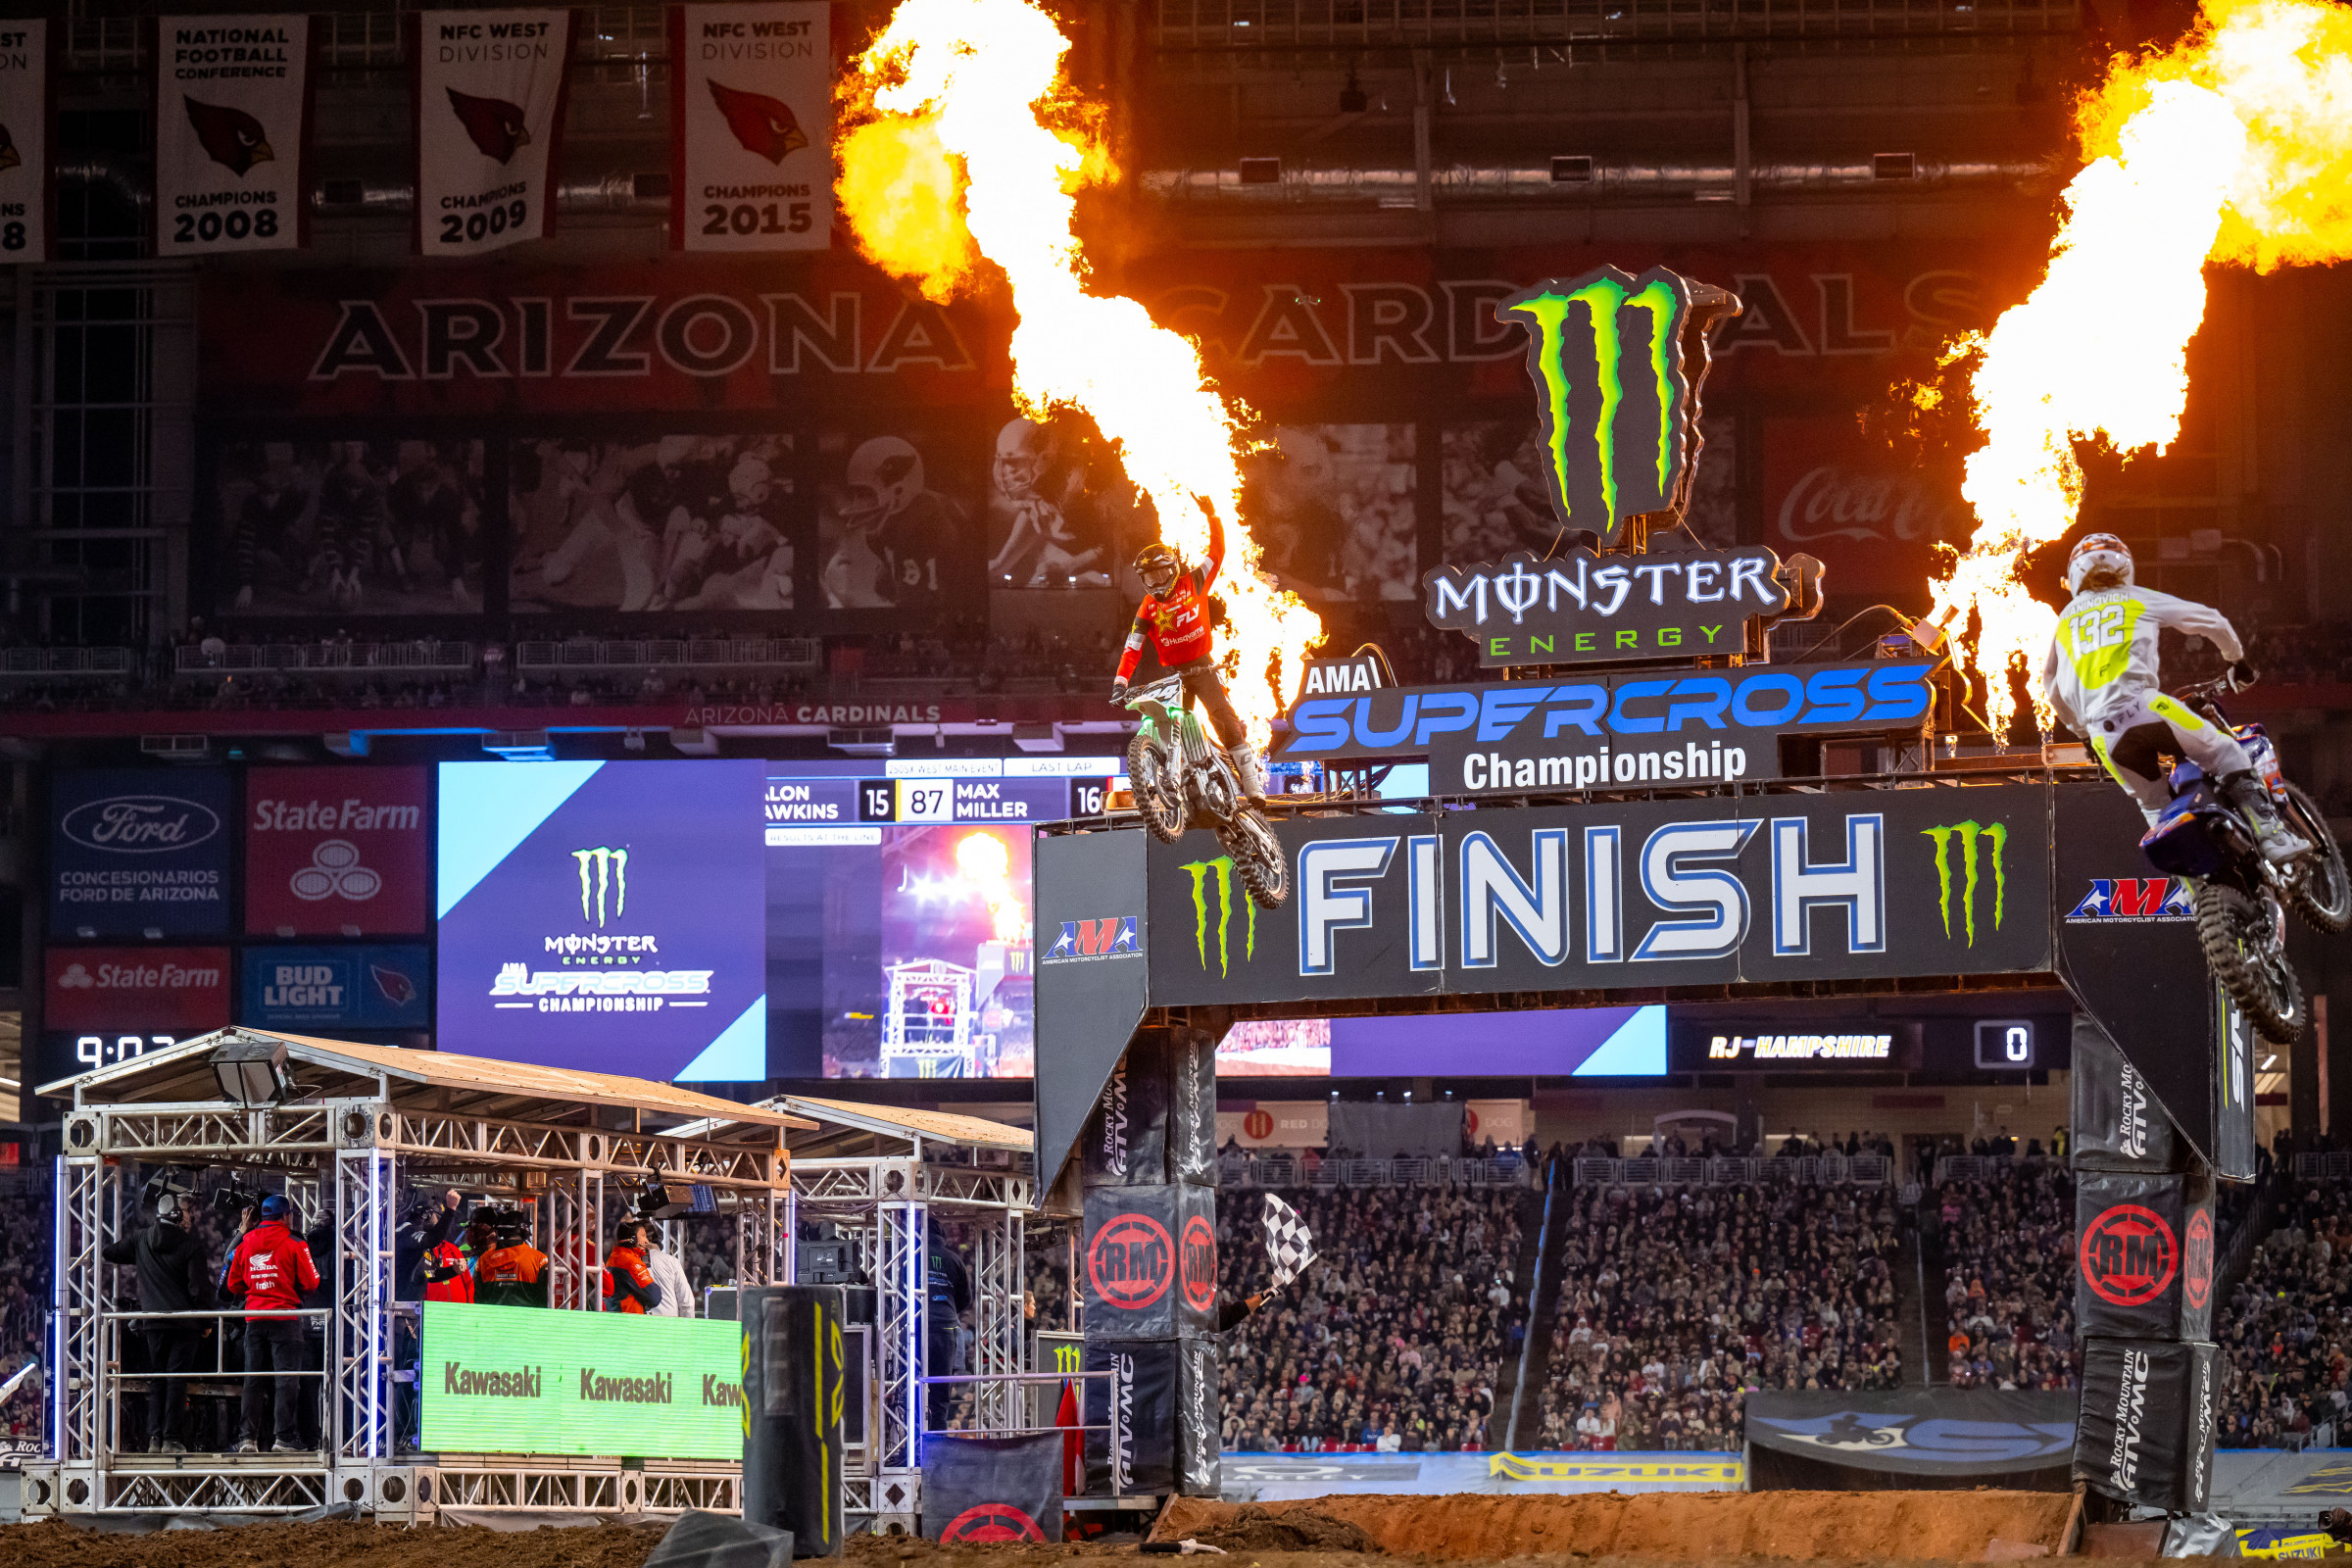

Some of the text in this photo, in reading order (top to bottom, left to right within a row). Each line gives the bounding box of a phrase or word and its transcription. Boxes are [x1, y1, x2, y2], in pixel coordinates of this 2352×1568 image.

[176, 29, 289, 44] NATIONAL
[440, 23, 549, 39] NFC WEST
[704, 22, 811, 37] NFC WEST
[175, 48, 287, 63] FOOTBALL
[439, 43, 548, 62] DIVISION
[703, 42, 811, 61] DIVISION
[175, 67, 285, 78] CONFERENCE
[175, 191, 277, 207] CHAMPIONS
[441, 181, 526, 209] CHAMPIONS
[704, 184, 810, 198] CHAMPIONS
[174, 209, 278, 242] 2008
[440, 200, 526, 243] 2009
[703, 203, 811, 235] 2015
[307, 293, 978, 381] ARIZONA
[1435, 558, 1778, 624] MONSTER
[1176, 604, 1200, 627] FLY
[1490, 624, 1723, 657] ENERGY
[2069, 605, 2125, 661] 132
[1305, 664, 1370, 694] AMA
[684, 706, 941, 724] ARIZONA CARDINALS
[1286, 663, 1934, 753] SUPERCROSS
[2118, 702, 2140, 723] FLY
[1031, 761, 1093, 772] LAST LAP
[1463, 740, 1745, 791] Championship
[765, 785, 809, 802] LON
[865, 789, 889, 816] 15
[911, 790, 944, 814] 87
[956, 784, 1000, 800] MAX
[1078, 787, 1101, 813] 16
[956, 802, 1027, 818] MILLER
[92, 803, 190, 844] Ford
[60, 870, 219, 885] CONCESIONARIOS
[60, 887, 220, 903] FORD DE ARIZONA
[1298, 813, 1886, 976] FINISH
[2064, 878, 2195, 917] AMA
[1041, 916, 1143, 959] AMA
[502, 962, 527, 974] AMA
[1069, 955, 1108, 963] MOTORCYCLIST
[275, 965, 334, 985] BUD
[490, 970, 714, 996] SUPERCROSS
[264, 986, 343, 1007] LIGHT
[539, 997, 663, 1012] CHAMPIONSHIP
[76, 1036, 175, 1069] 9:0
[1709, 1035, 1891, 1059] RJ HAMPSHIRE
[2006, 1027, 2028, 1061] 0
[1280, 1118, 1308, 1129] RED
[2119, 1091, 2132, 1137] ROCKY
[1103, 1111, 1114, 1154] ROCKY
[1104, 1240, 1160, 1282] RM
[1186, 1242, 1212, 1282] RM
[2100, 1234, 2159, 1276] RM
[445, 1361, 541, 1398] Kawasaki
[580, 1367, 671, 1404] Kawasaki
[2110, 1348, 2134, 1468] ROCKY MOUNTAIN
[16, 1441, 41, 1452] ROC
[2278, 1545, 2322, 1560] SUZUKI
